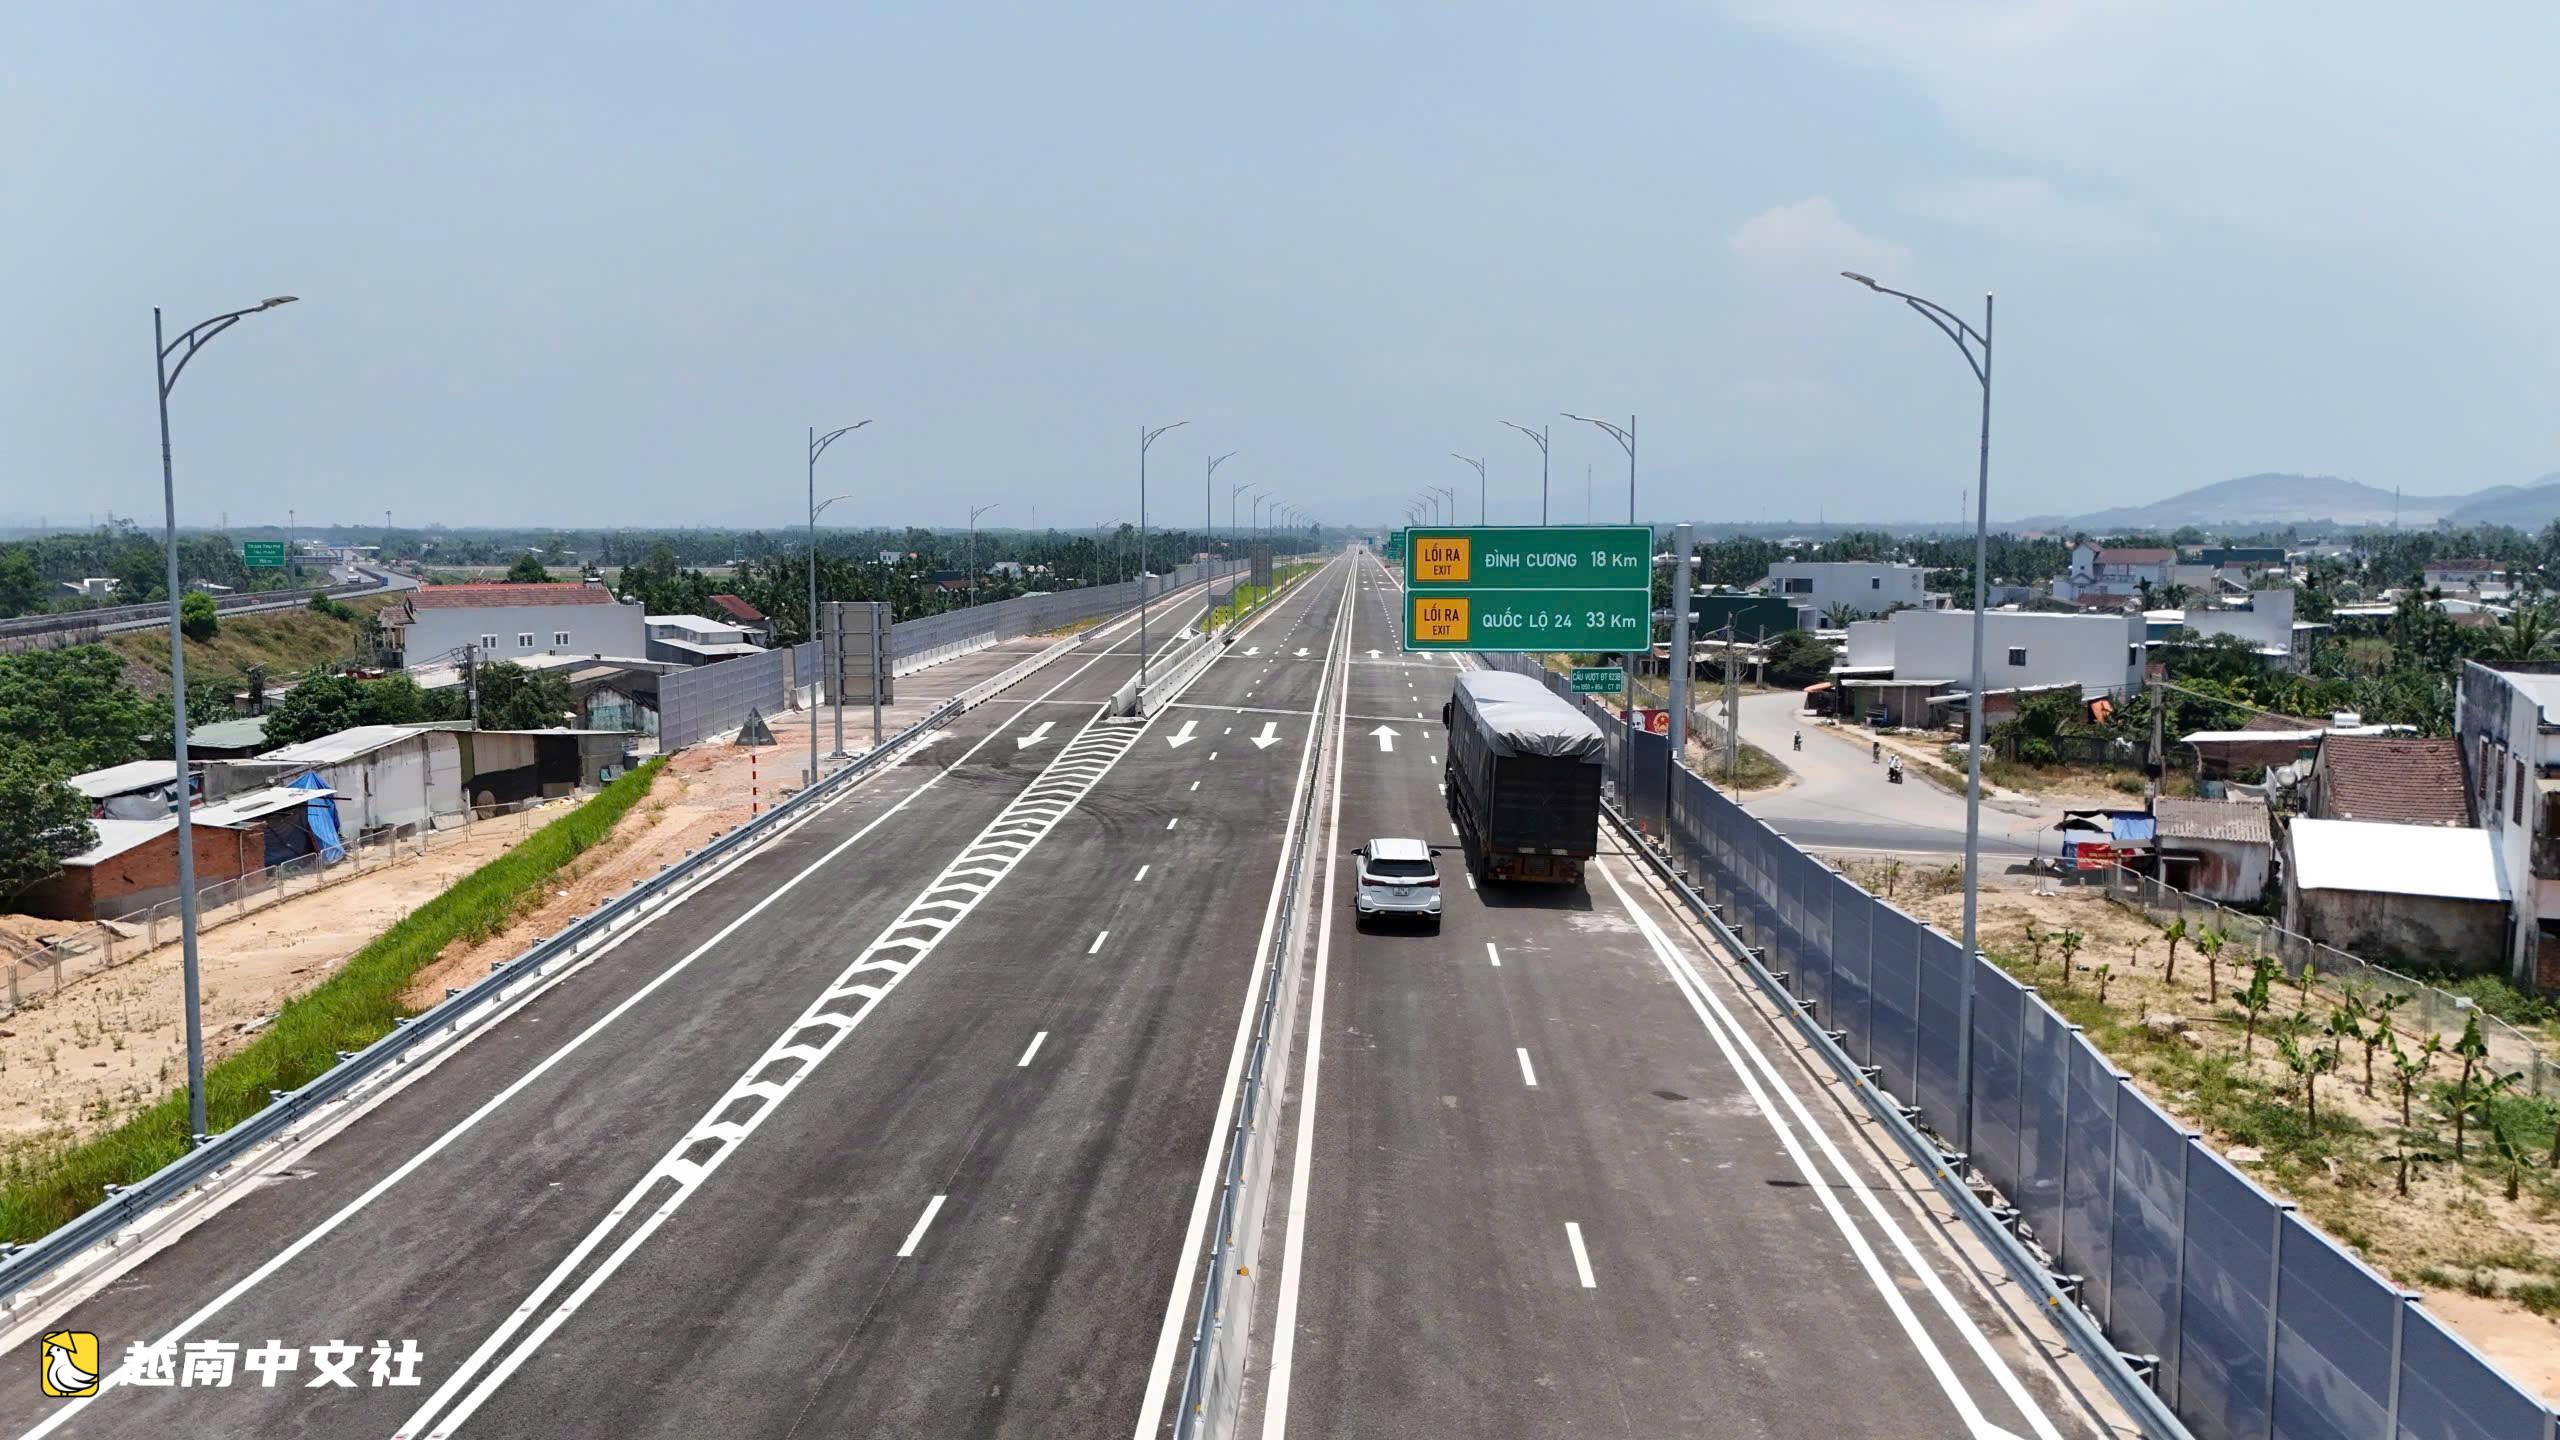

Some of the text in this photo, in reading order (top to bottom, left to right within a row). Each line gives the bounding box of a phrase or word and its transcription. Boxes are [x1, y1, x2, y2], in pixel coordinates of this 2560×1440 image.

[1425, 543, 1461, 562] LỐI RA
[1485, 549, 1637, 567] ĐÌNH CƯƠNG 18 Km
[1433, 565, 1452, 576] EXIT
[1424, 603, 1460, 622] LỐI RA
[1482, 607, 1636, 631] QUỐC LỘ 24 33 Km
[1432, 625, 1451, 636] EXIT
